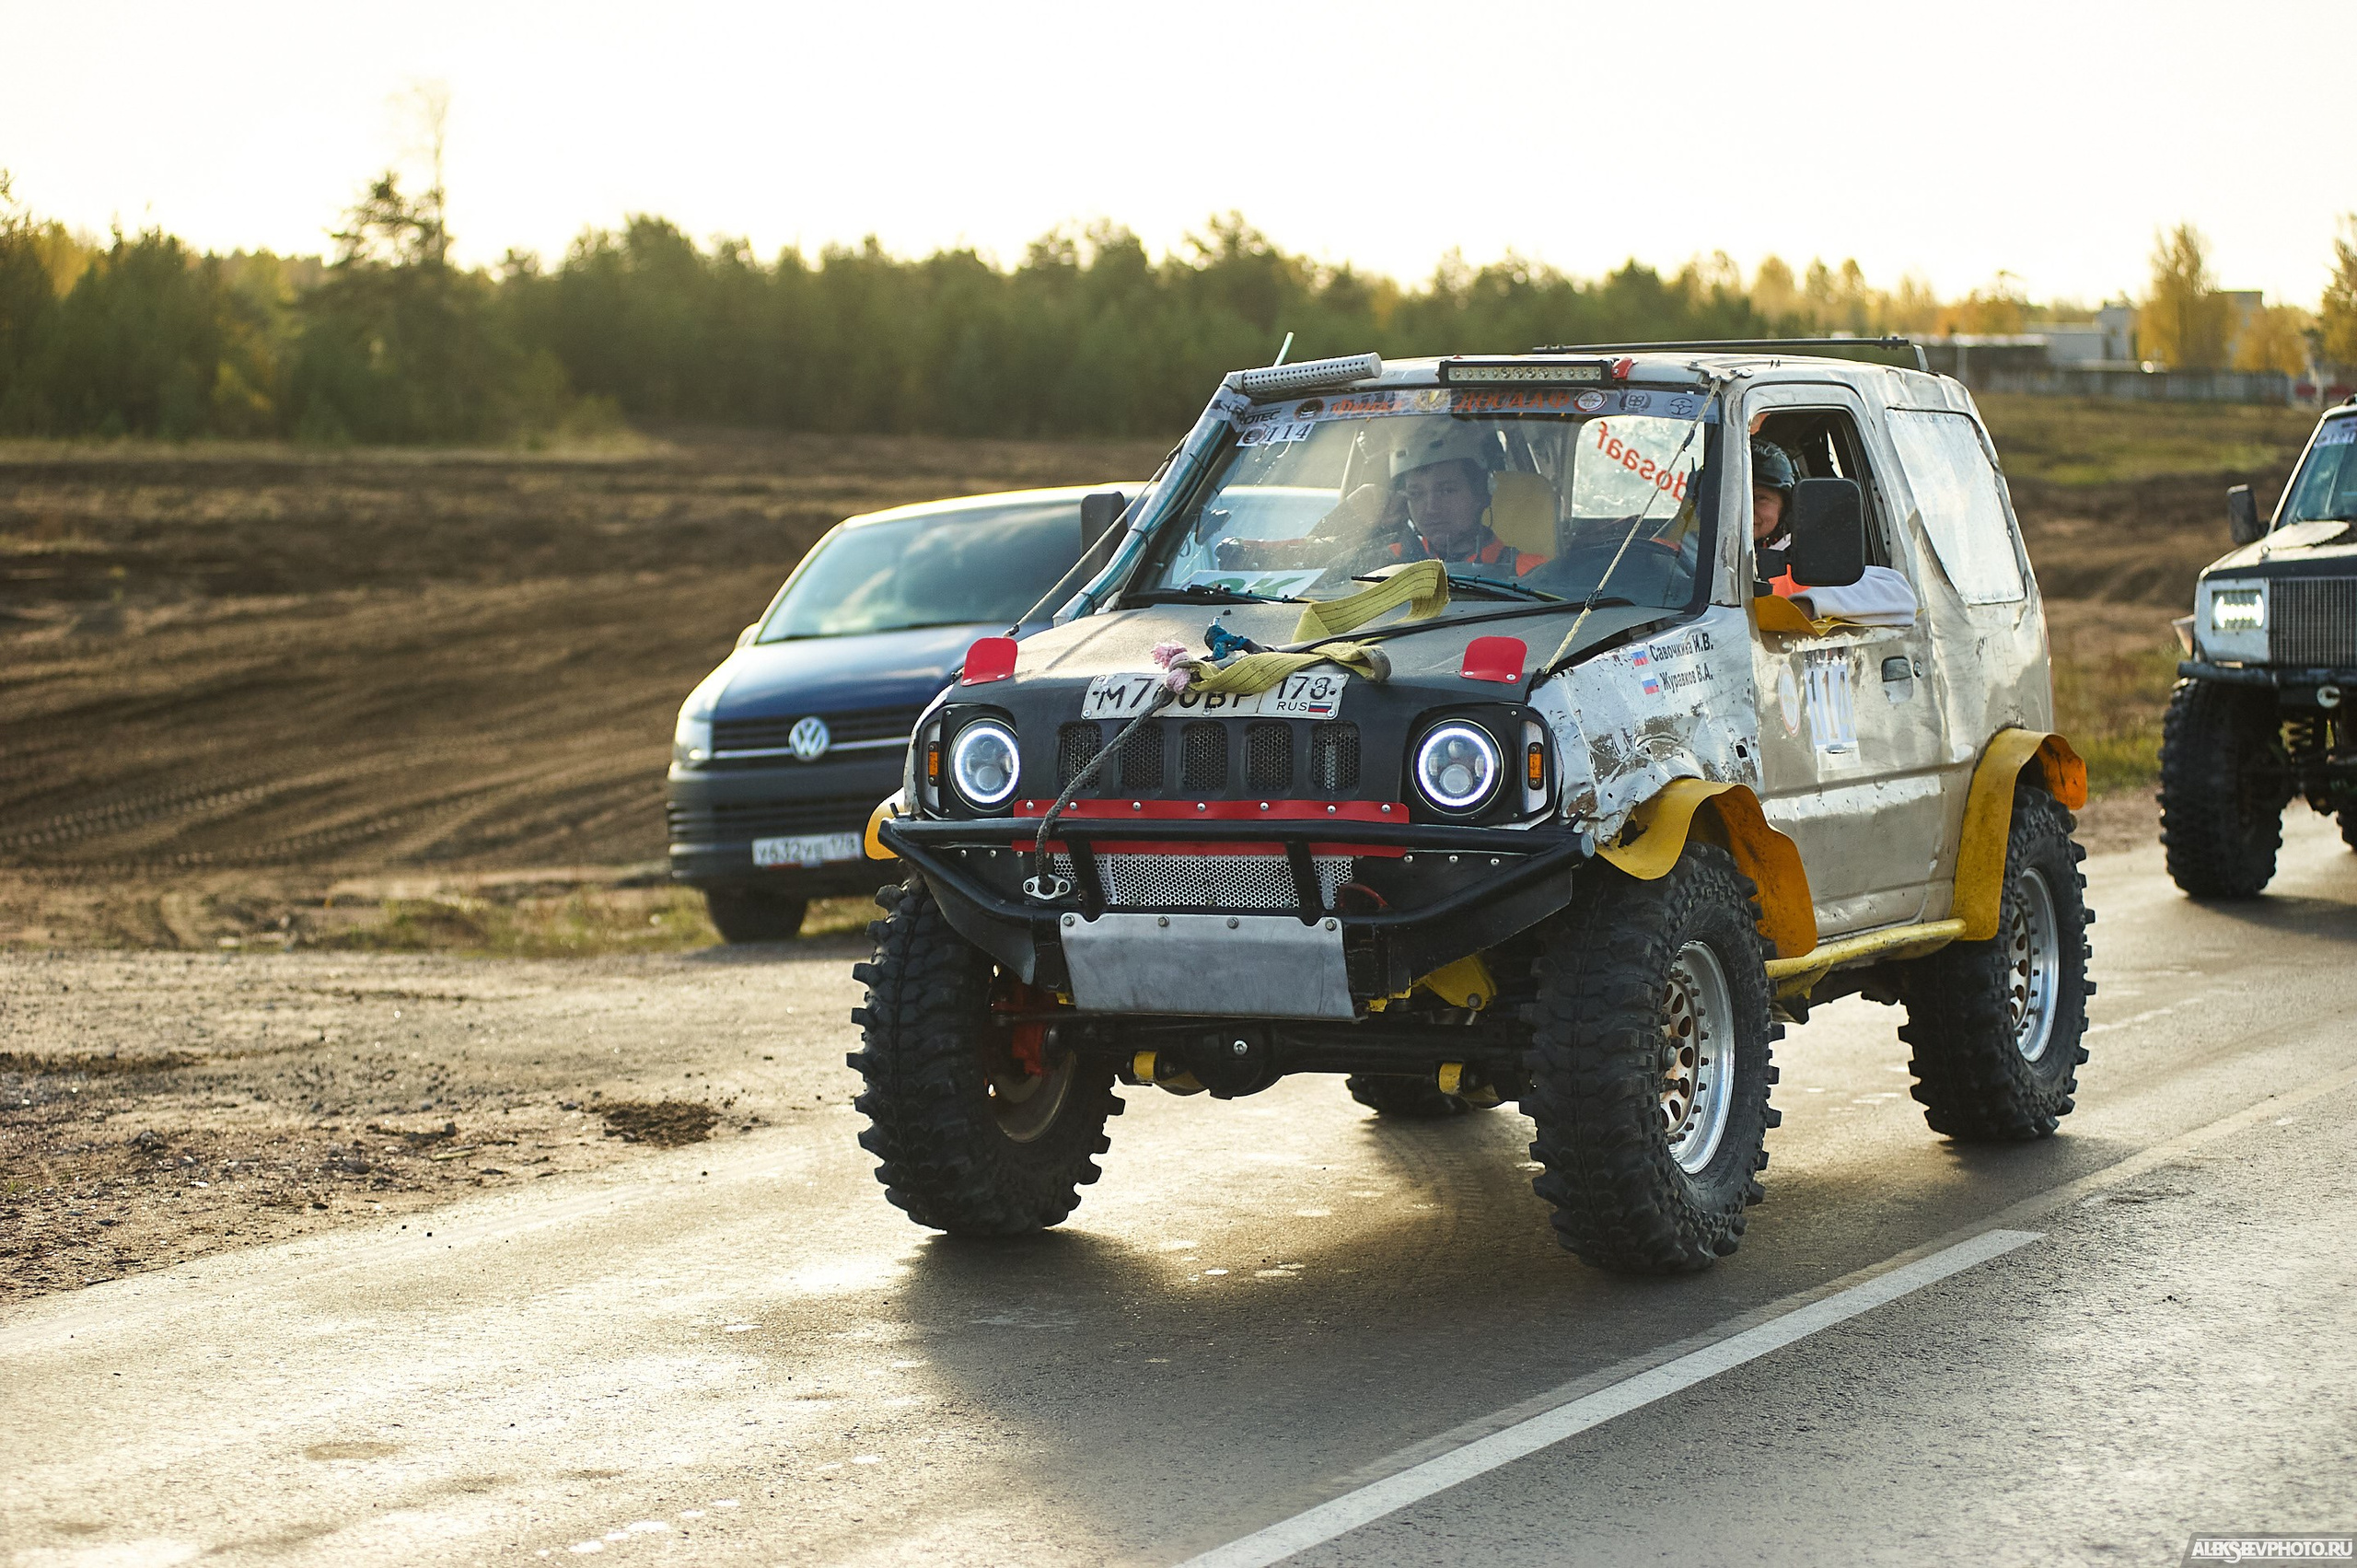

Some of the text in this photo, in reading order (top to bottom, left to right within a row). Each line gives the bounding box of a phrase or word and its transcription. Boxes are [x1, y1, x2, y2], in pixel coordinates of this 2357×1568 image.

[1454, 391, 1570, 412] ДОСААФ
[1265, 424, 1312, 442] 114
[1277, 676, 1331, 700] 178
[1276, 702, 1308, 711] RUS
